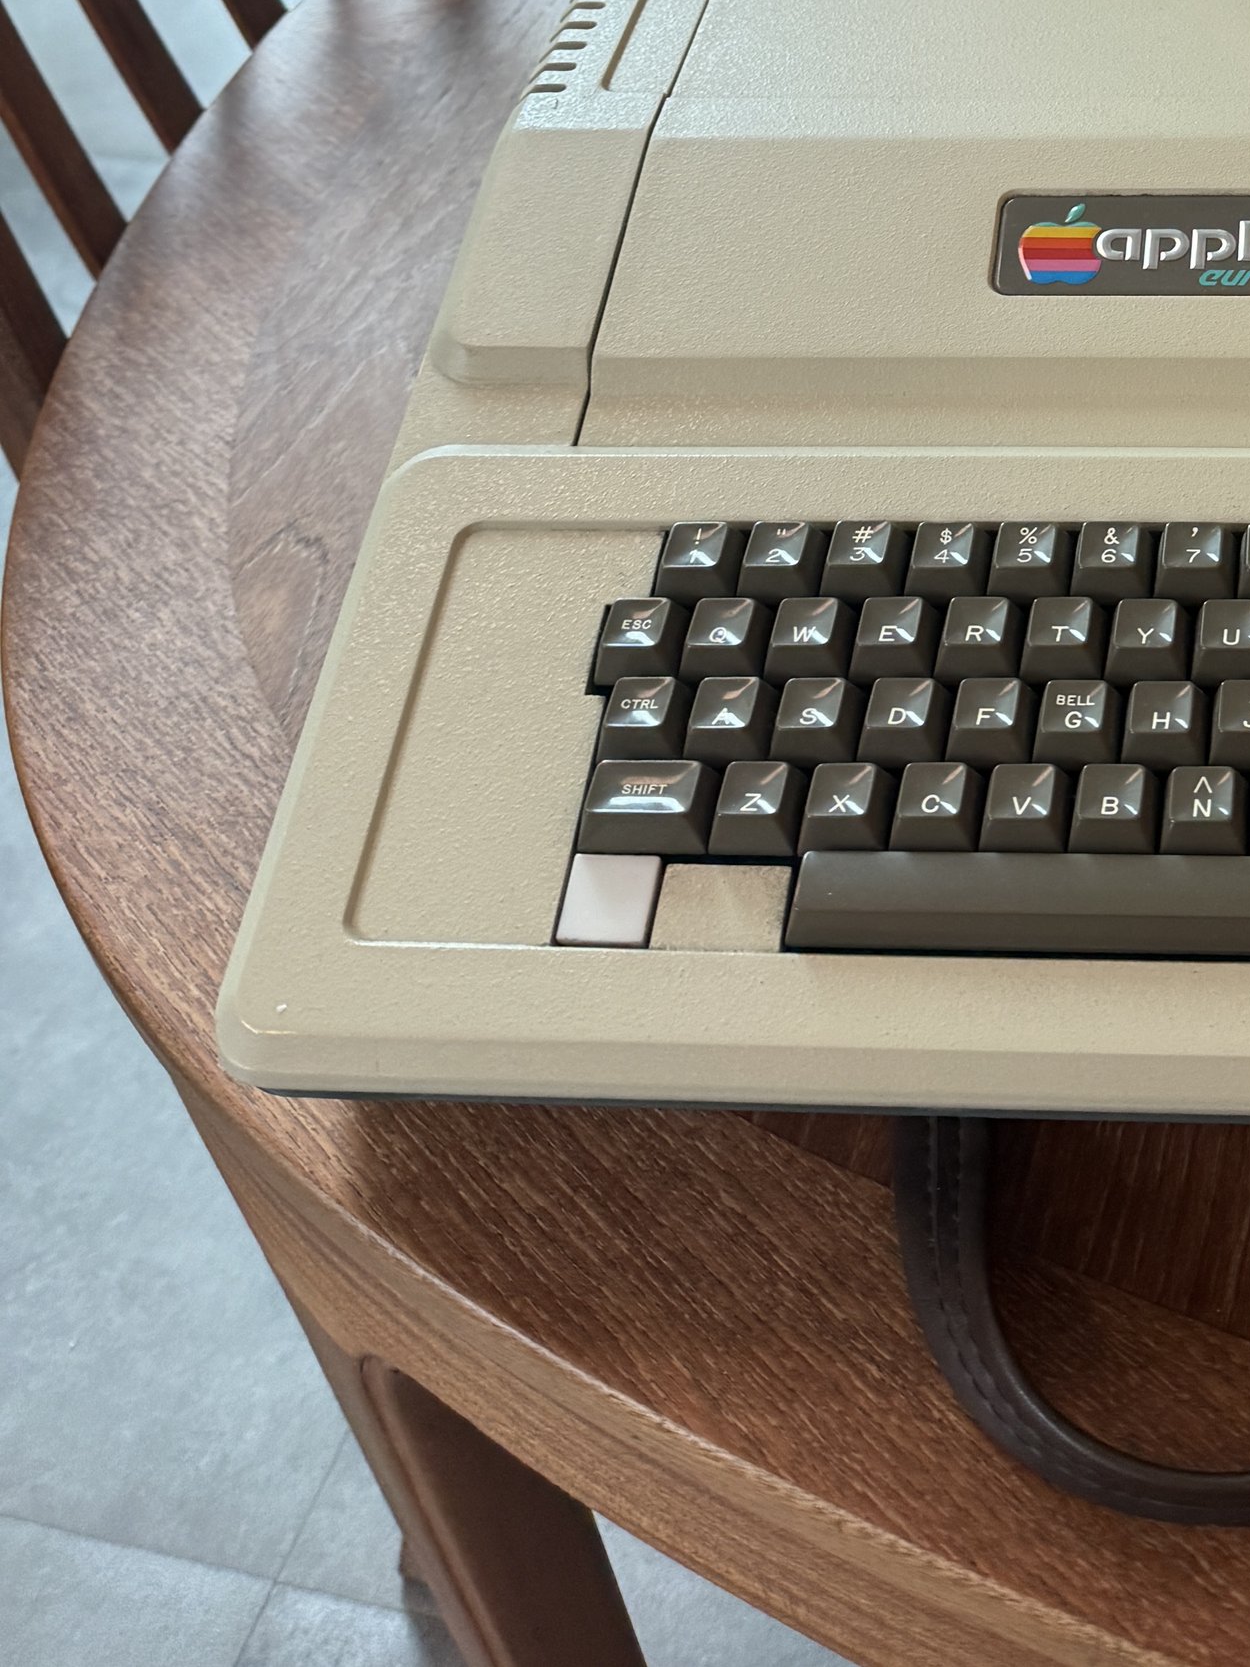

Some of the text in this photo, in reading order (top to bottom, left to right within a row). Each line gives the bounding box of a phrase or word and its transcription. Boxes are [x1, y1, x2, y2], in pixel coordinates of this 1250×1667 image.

[852, 525, 874, 544] #
[939, 527, 953, 545] $
[1018, 527, 1038, 545] %
[1103, 527, 1120, 545] &
[765, 548, 784, 564] 2
[850, 547, 867, 563] 3
[934, 548, 950, 564] 4
[1016, 548, 1034, 564] 5
[1101, 548, 1117, 564] 6
[1185, 548, 1201, 564] 7
[620, 618, 652, 631] ESC
[878, 625, 898, 642] E
[964, 625, 985, 642] R
[1051, 625, 1070, 642] T
[709, 626, 728, 644] Q
[792, 625, 817, 643] W
[1137, 627, 1155, 645] Y
[1222, 628, 1241, 646] U
[620, 698, 659, 710] CTRL
[1055, 694, 1096, 707] BELL
[711, 707, 731, 726] A
[799, 707, 819, 725] S
[887, 707, 908, 725] D
[975, 707, 996, 726] F
[1064, 710, 1082, 729] G
[1151, 711, 1171, 730] H
[621, 783, 668, 795] SHIFT
[739, 792, 763, 813] Z
[827, 794, 851, 813] X
[920, 794, 941, 814] C
[1011, 795, 1032, 816] V
[1100, 796, 1120, 816] B
[1192, 798, 1212, 818] N
